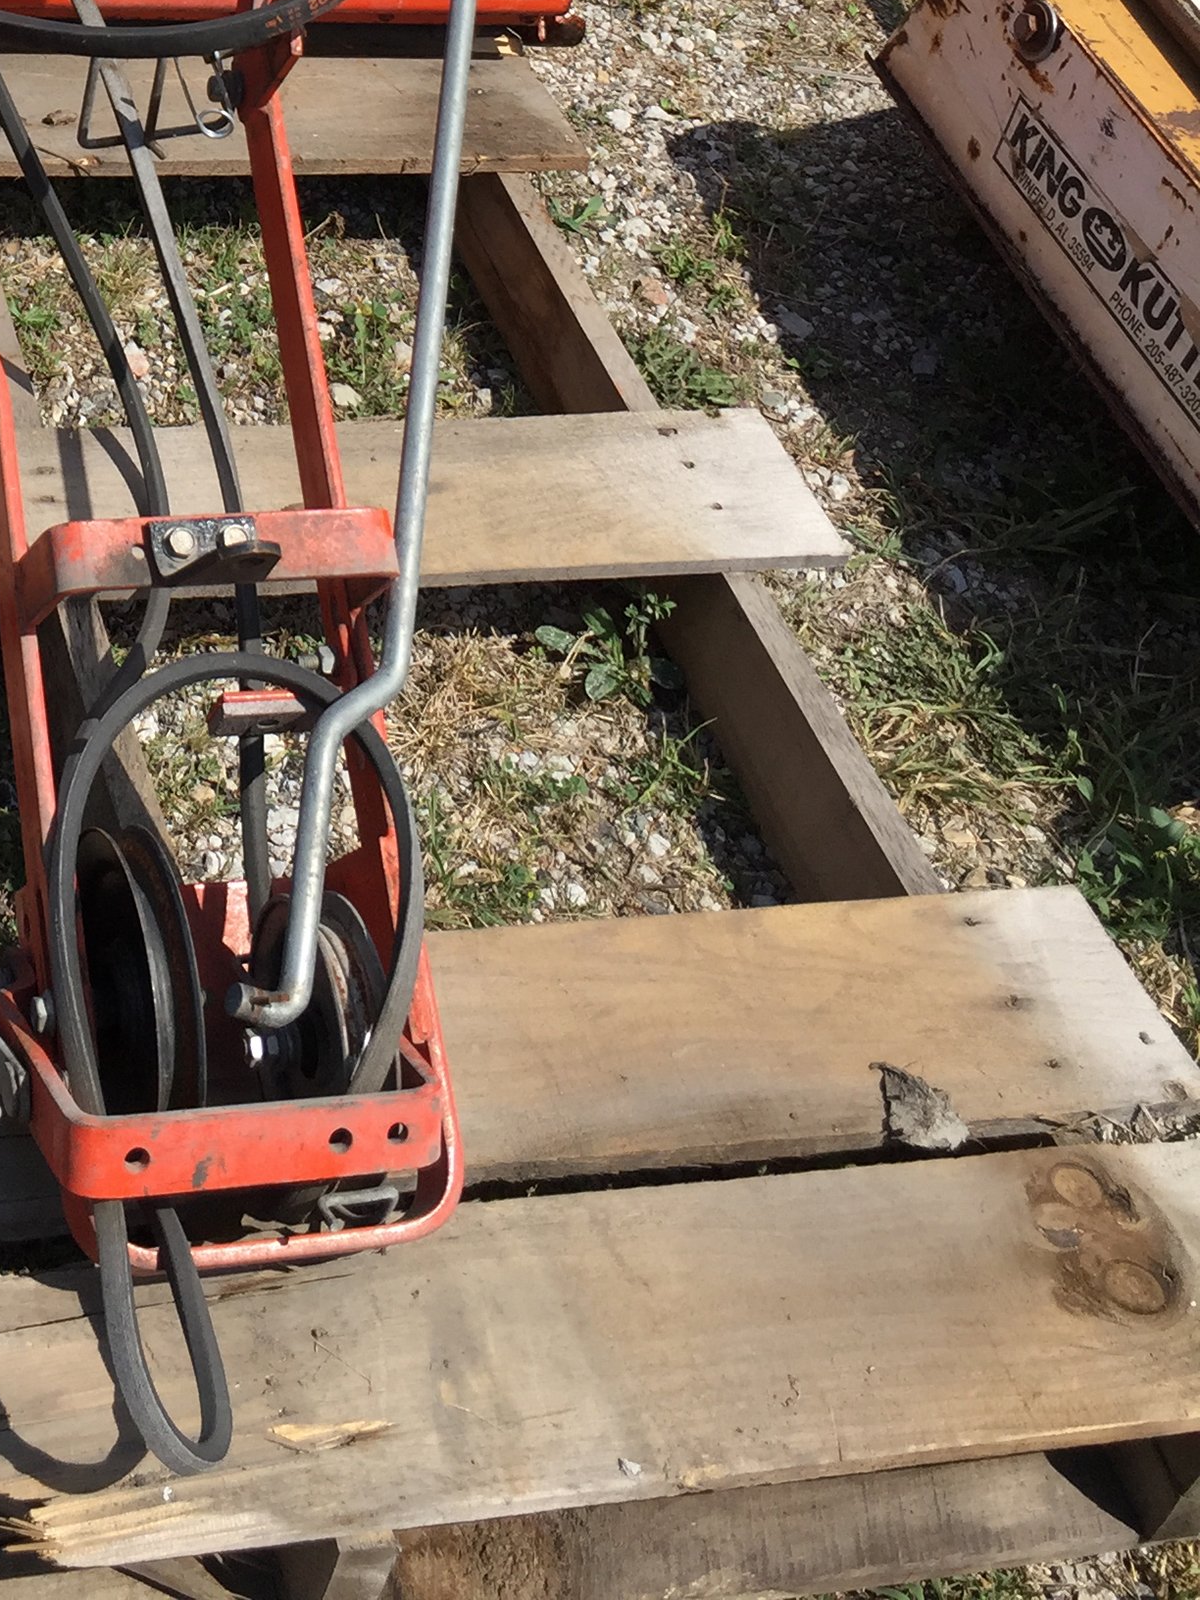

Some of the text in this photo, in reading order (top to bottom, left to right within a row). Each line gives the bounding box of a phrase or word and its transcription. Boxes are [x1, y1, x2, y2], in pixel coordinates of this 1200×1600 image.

[1010, 113, 1200, 390] KING KUTT
[1055, 221, 1071, 242] AL
[1067, 236, 1096, 274] 35594
[1109, 290, 1146, 342] PHONE:
